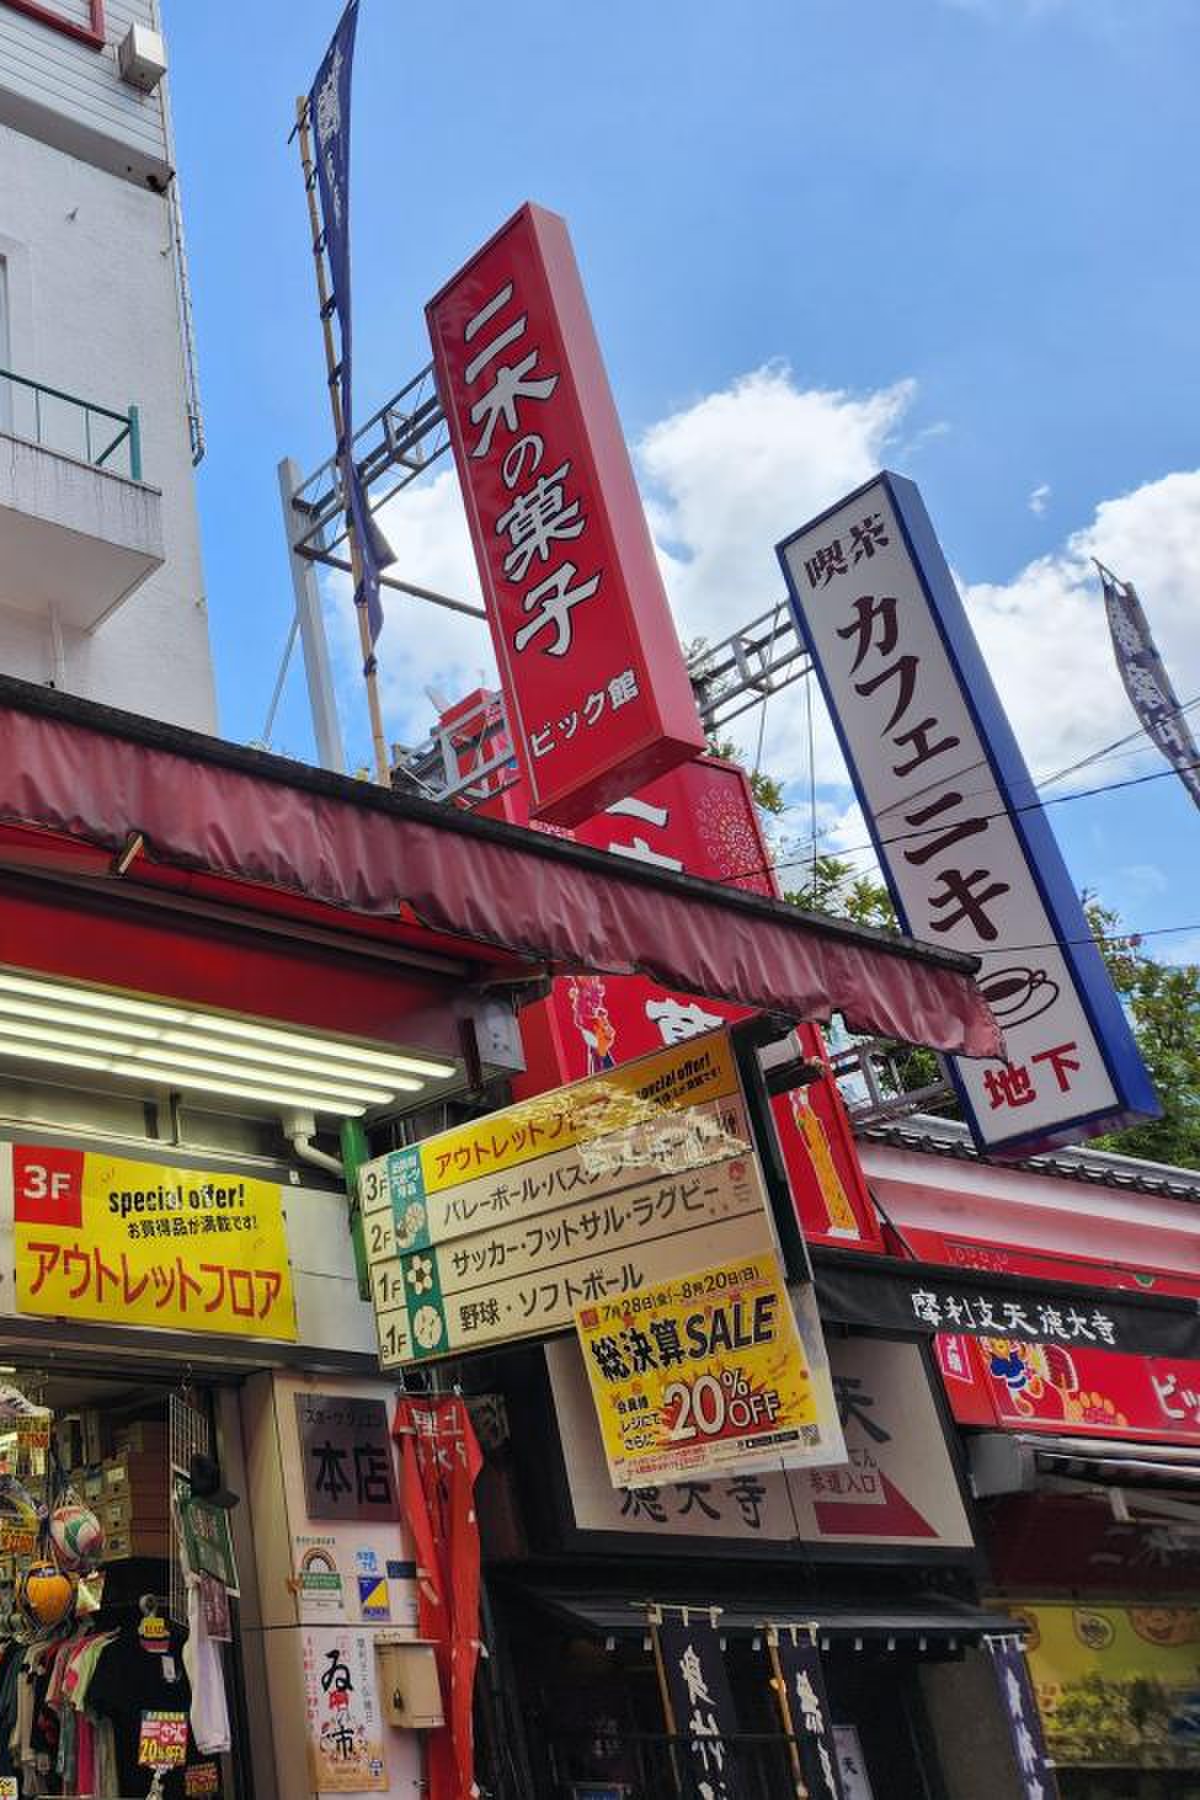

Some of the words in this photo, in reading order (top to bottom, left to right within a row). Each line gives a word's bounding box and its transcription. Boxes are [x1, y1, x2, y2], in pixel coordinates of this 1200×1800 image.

[464, 282, 601, 656] 二木の菓子
[803, 512, 890, 588] 喫茶
[531, 669, 640, 759] ビック館
[983, 1041, 1082, 1110] 地下
[22, 1164, 73, 1201] 3F
[108, 1184, 185, 1217] special
[188, 1183, 246, 1211] offer!
[366, 1172, 388, 1201] 3F
[370, 1224, 391, 1251] 2F
[26, 1240, 282, 1320] アウトレットフロア
[377, 1272, 400, 1299] 1F
[311, 1441, 392, 1505] 本店
